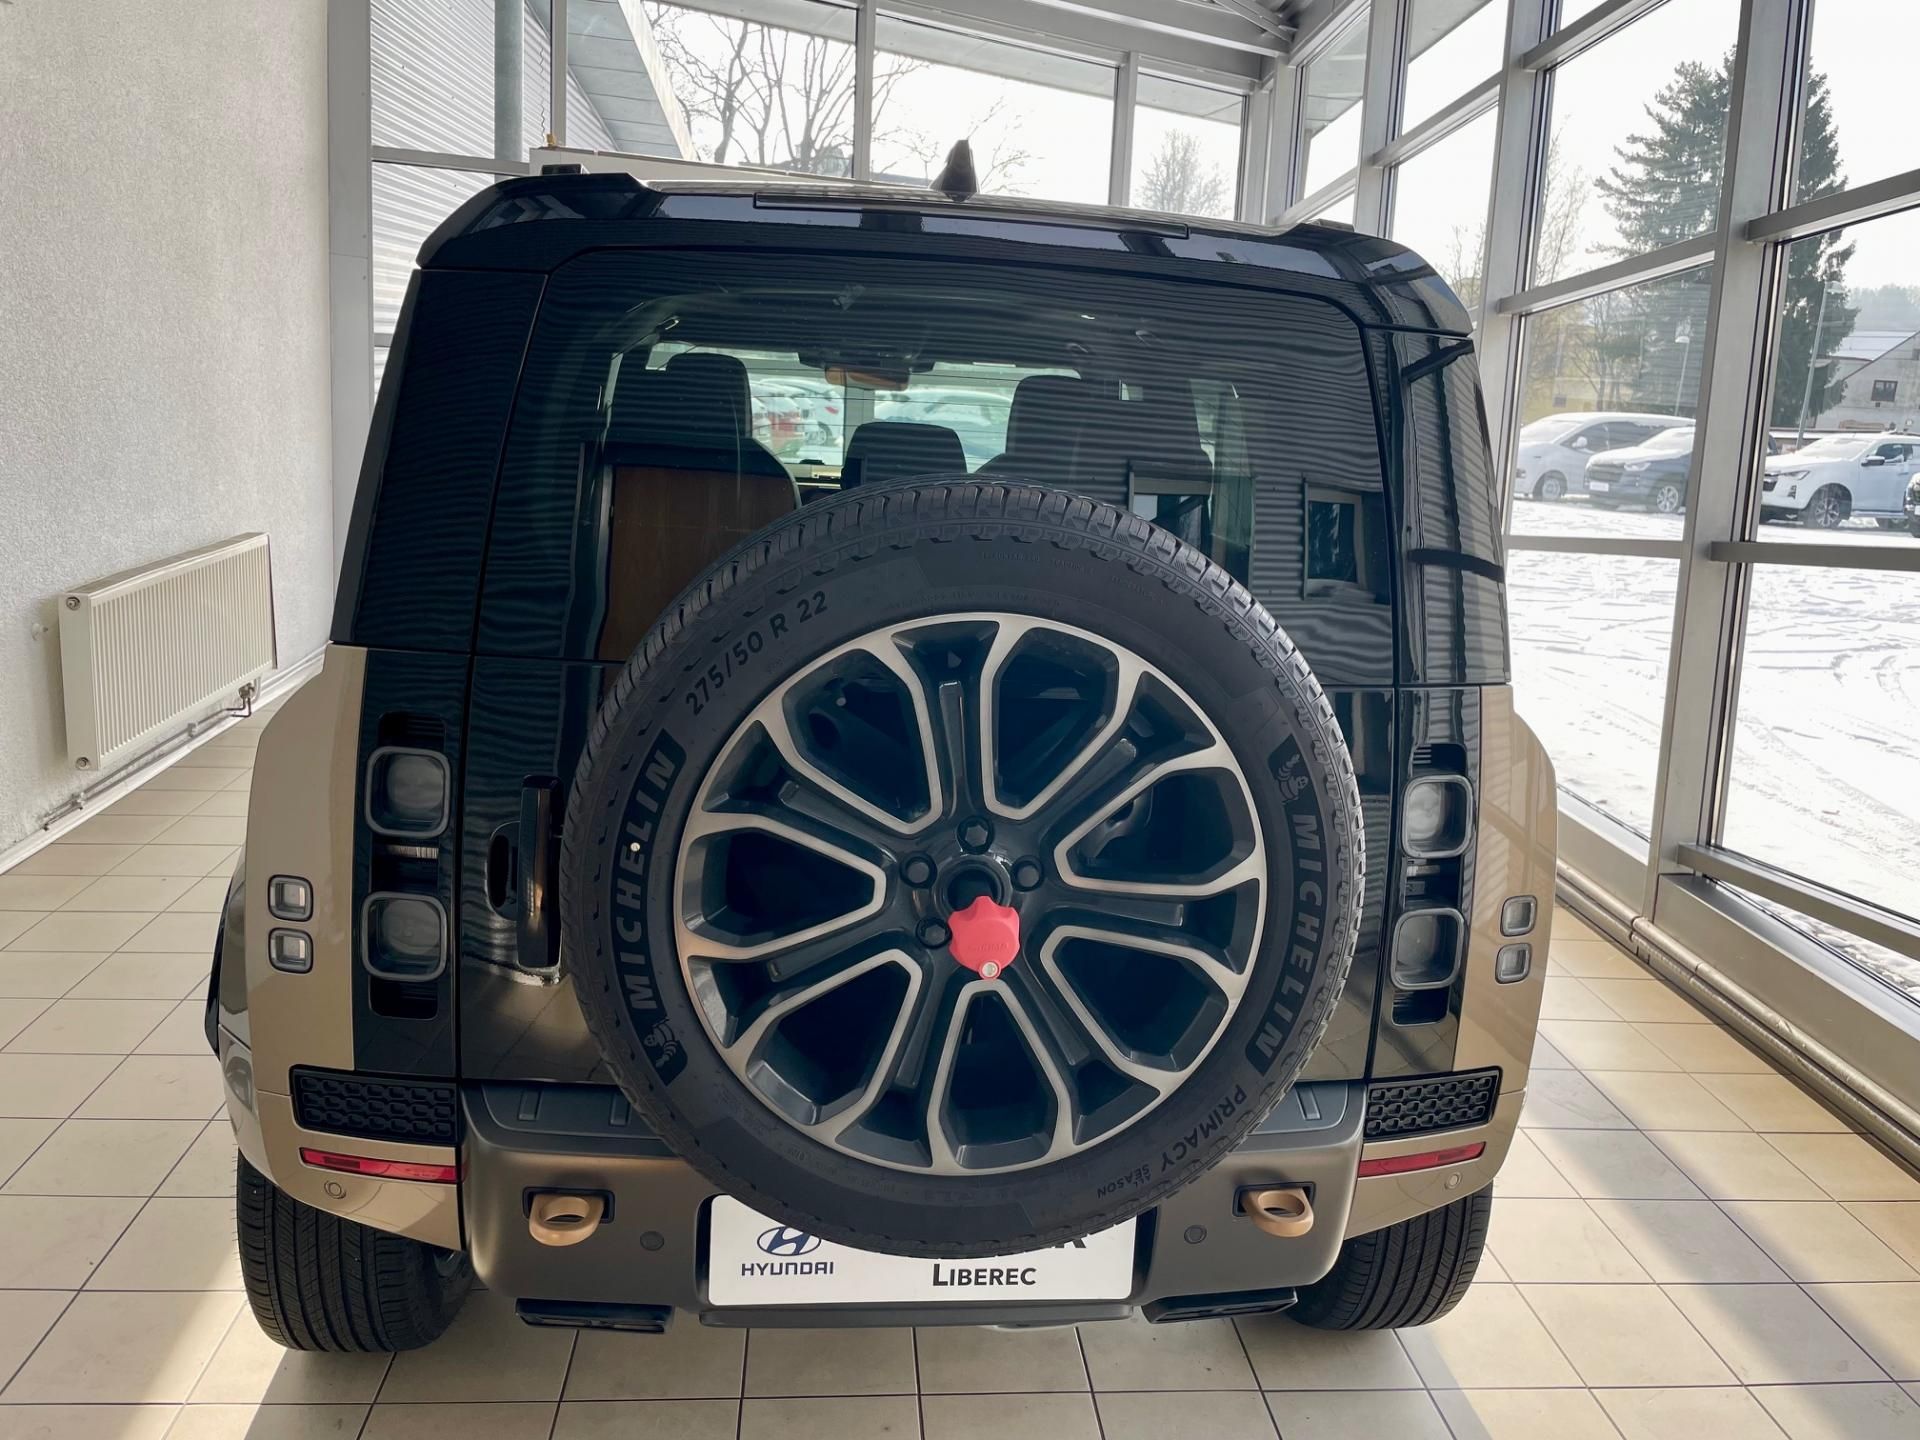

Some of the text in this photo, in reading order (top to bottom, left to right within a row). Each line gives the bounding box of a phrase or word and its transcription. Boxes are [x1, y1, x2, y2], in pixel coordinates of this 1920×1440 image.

[686, 590, 828, 715] 275/50 R 22
[615, 749, 676, 1010] MICHELIN
[1255, 813, 1322, 1059] MICHELIN
[1161, 1084, 1247, 1172] PRIMACY
[1097, 1164, 1150, 1199] SEASON
[741, 1261, 834, 1276] HYUNDAI
